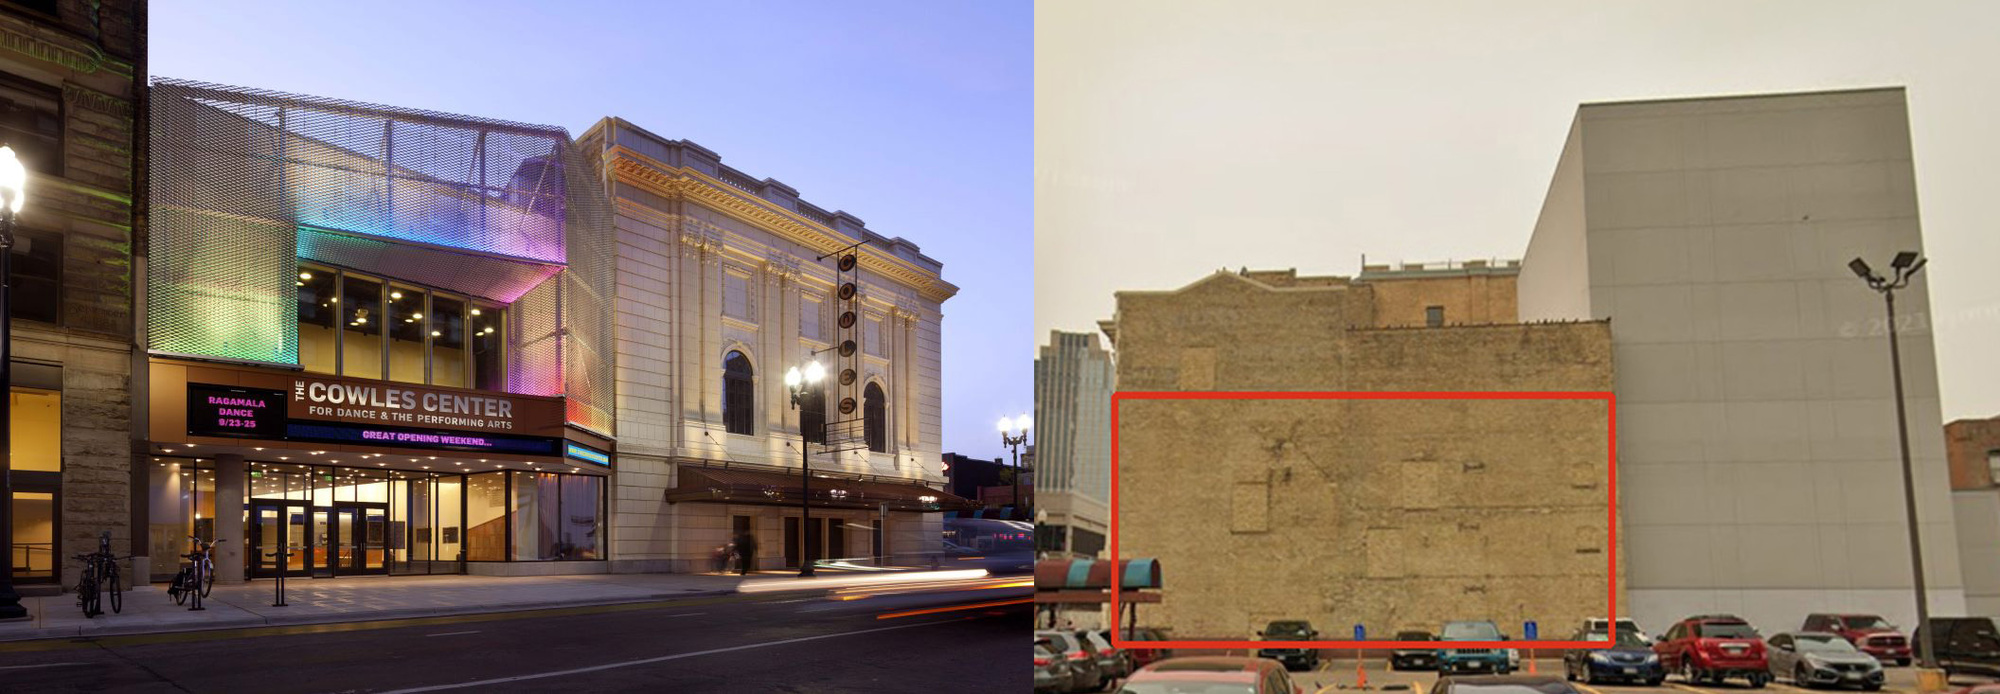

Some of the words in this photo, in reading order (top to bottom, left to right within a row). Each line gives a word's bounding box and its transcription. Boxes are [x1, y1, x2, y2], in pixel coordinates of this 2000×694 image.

[839, 254, 857, 414] COWLES
[295, 381, 305, 401] THE
[208, 396, 266, 408] RAGAMALA
[309, 382, 417, 410] COWLES
[422, 392, 513, 419] CENTER
[218, 408, 254, 418] DANCE
[309, 405, 333, 416] FOR
[337, 408, 376, 419] DANCE
[380, 411, 388, 420] &
[391, 412, 413, 422] THE
[417, 414, 484, 428] PERFORMING
[487, 420, 512, 430] ARTS
[218, 418, 256, 428] 9/23-25
[362, 430, 396, 441] GREAT
[397, 432, 439, 444] OPENING
[440, 435, 492, 447] WEEKEND...
